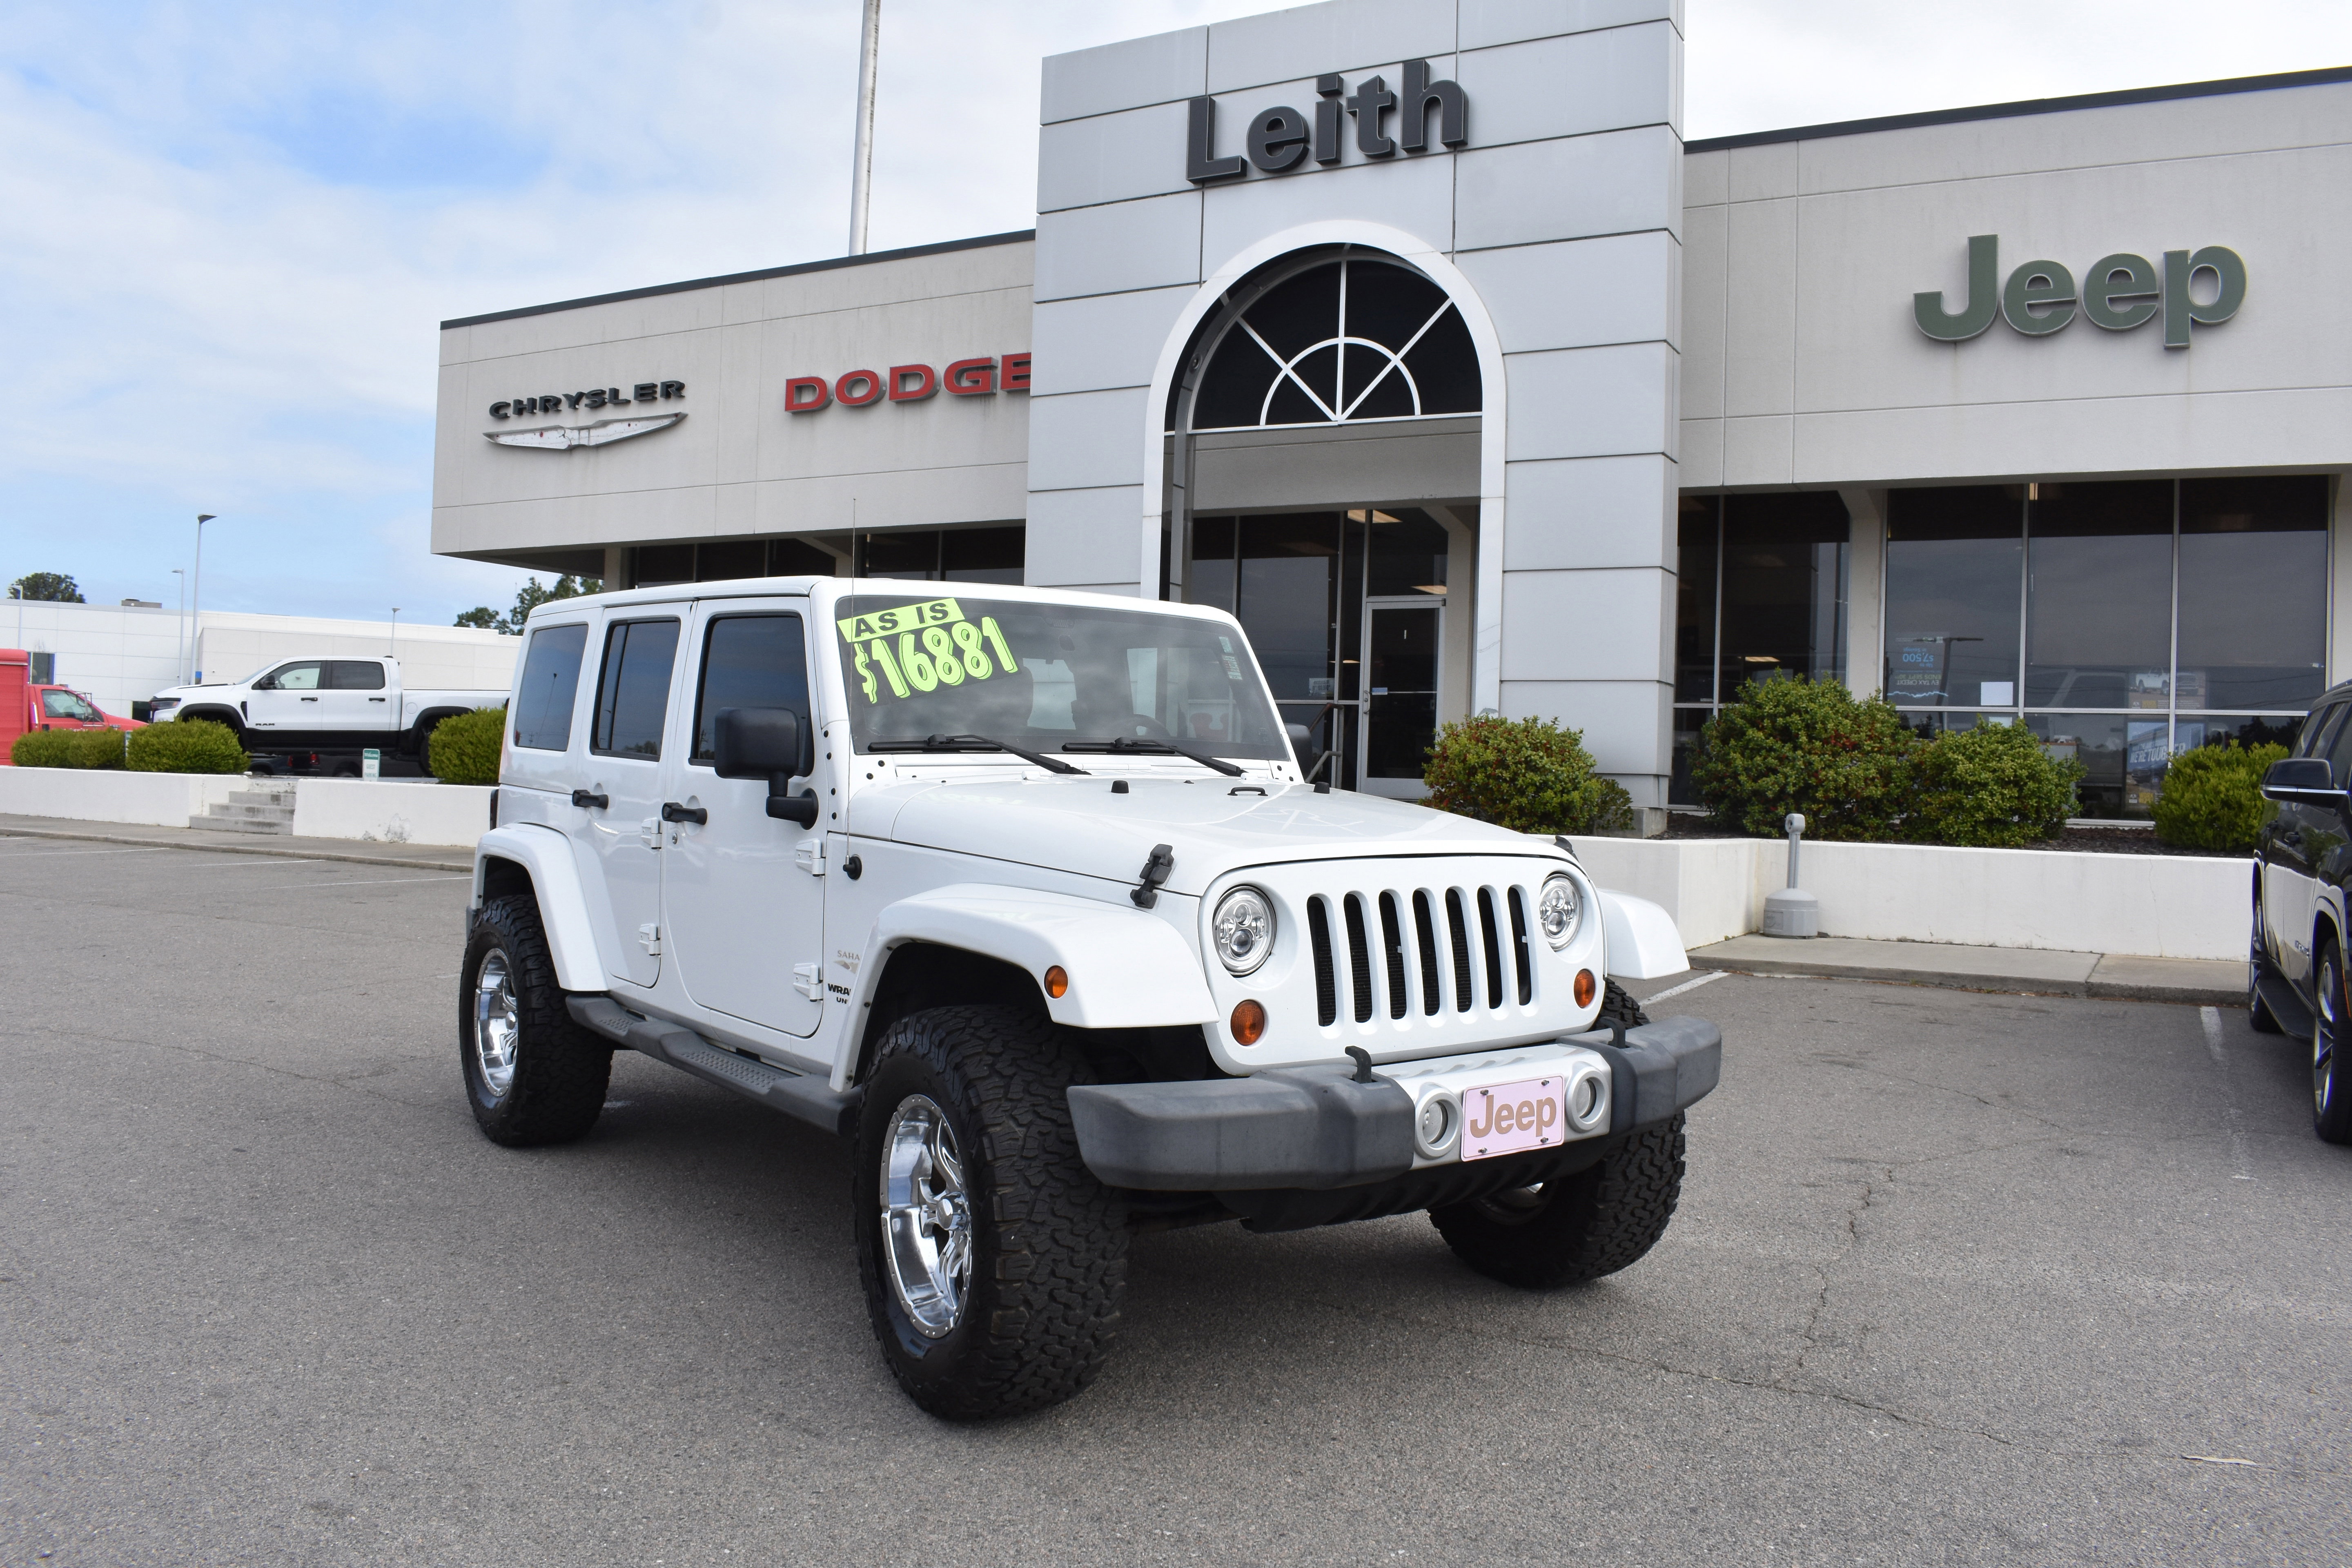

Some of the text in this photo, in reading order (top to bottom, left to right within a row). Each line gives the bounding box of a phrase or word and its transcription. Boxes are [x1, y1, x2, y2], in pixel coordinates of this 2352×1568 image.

[1186, 59, 1468, 185] Leith
[1913, 234, 2247, 349] Jeep
[488, 379, 686, 419] CHRYSLER
[784, 352, 1031, 413] DODGE
[855, 602, 949, 638] AS IS
[854, 616, 1018, 704] $16881
[2148, 742, 2185, 762] TOUGER
[828, 983, 851, 996] WRA
[1470, 1095, 1557, 1138] Jeep
